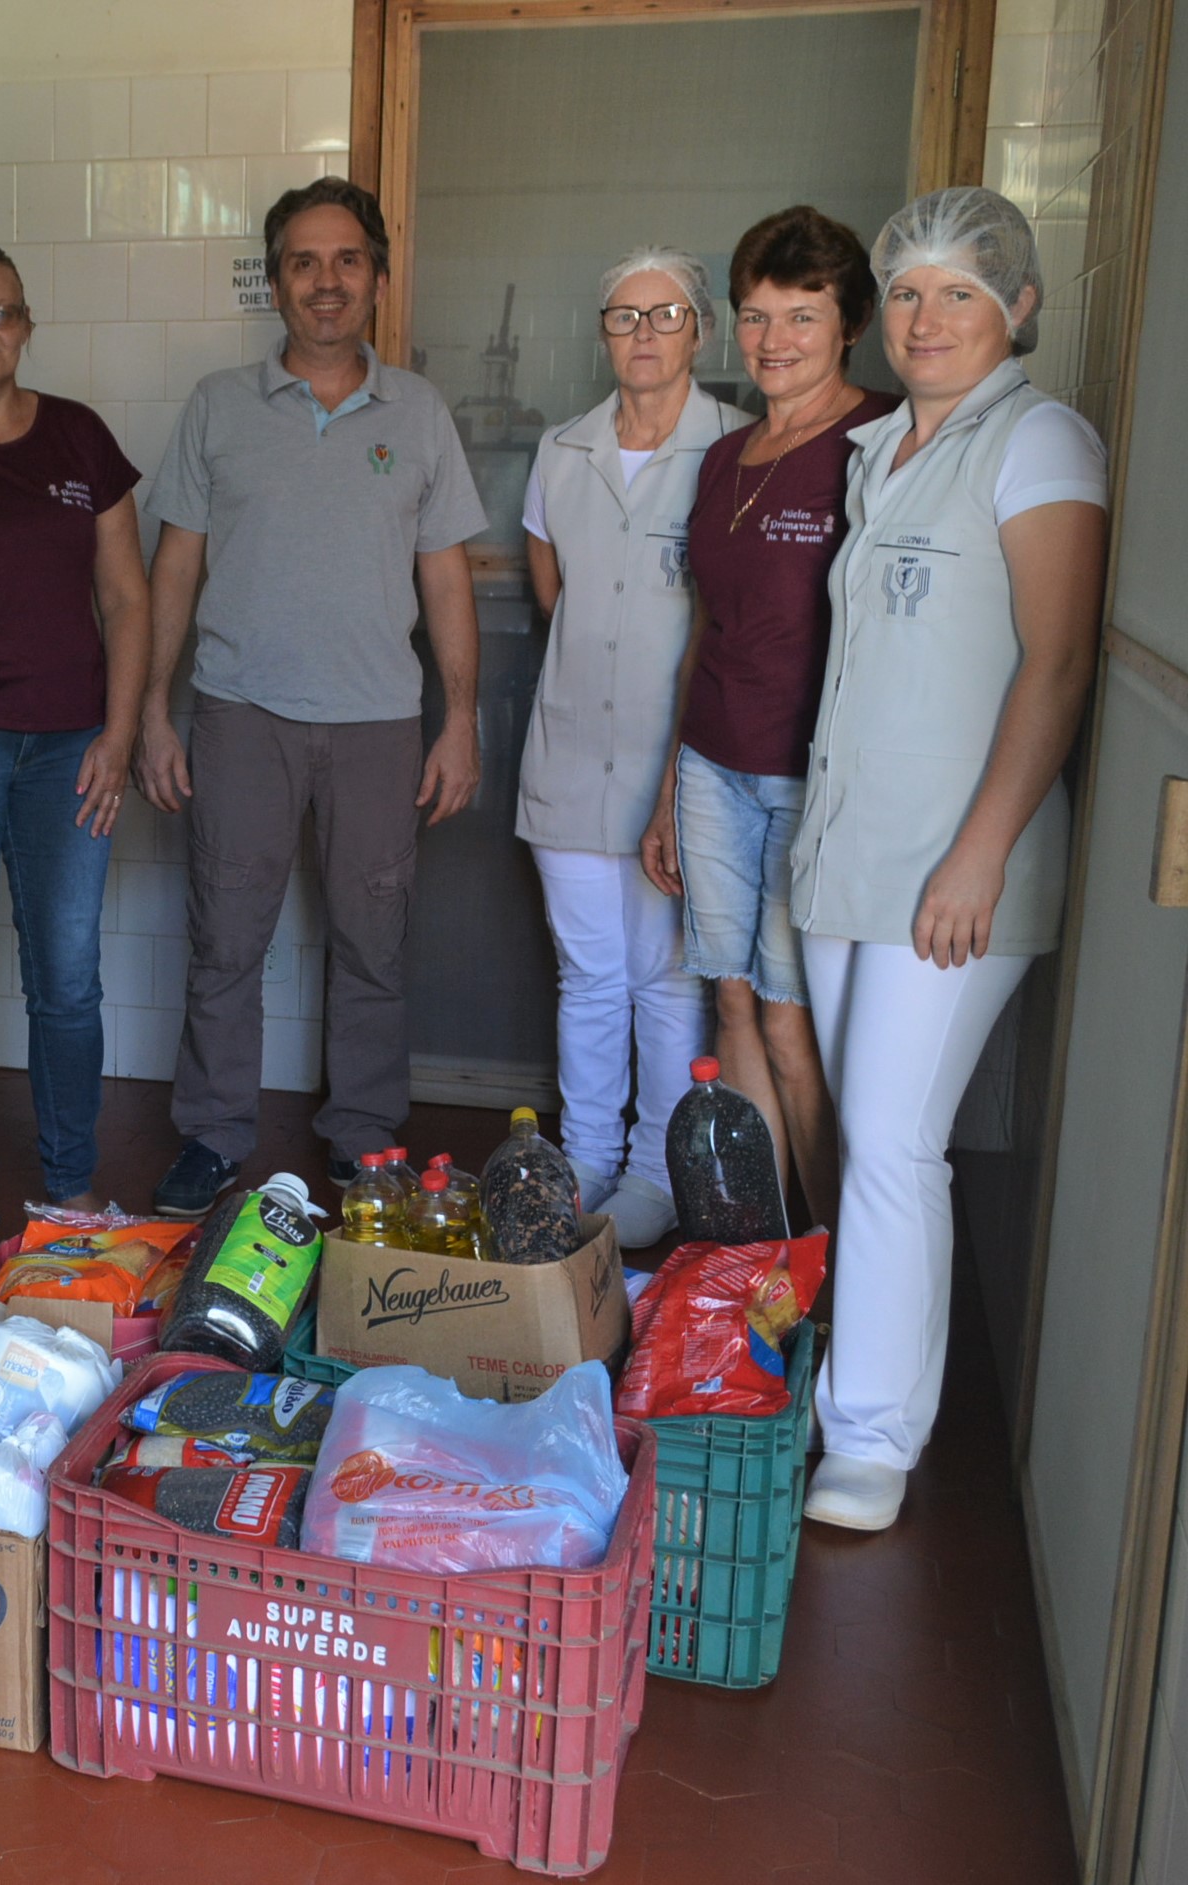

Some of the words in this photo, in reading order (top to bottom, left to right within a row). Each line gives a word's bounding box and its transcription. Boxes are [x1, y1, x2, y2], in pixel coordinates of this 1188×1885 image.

[769, 520, 821, 532] Primavera
[897, 535, 931, 546] COZINHA
[361, 1267, 510, 1328] Neugebauer
[3, 1360, 39, 1377] macio
[467, 1355, 508, 1374] TEME
[512, 1361, 566, 1379] CALOR
[231, 1473, 276, 1526] MANU
[266, 1601, 355, 1634] SUPER
[226, 1617, 387, 1667] AURIVERDE
